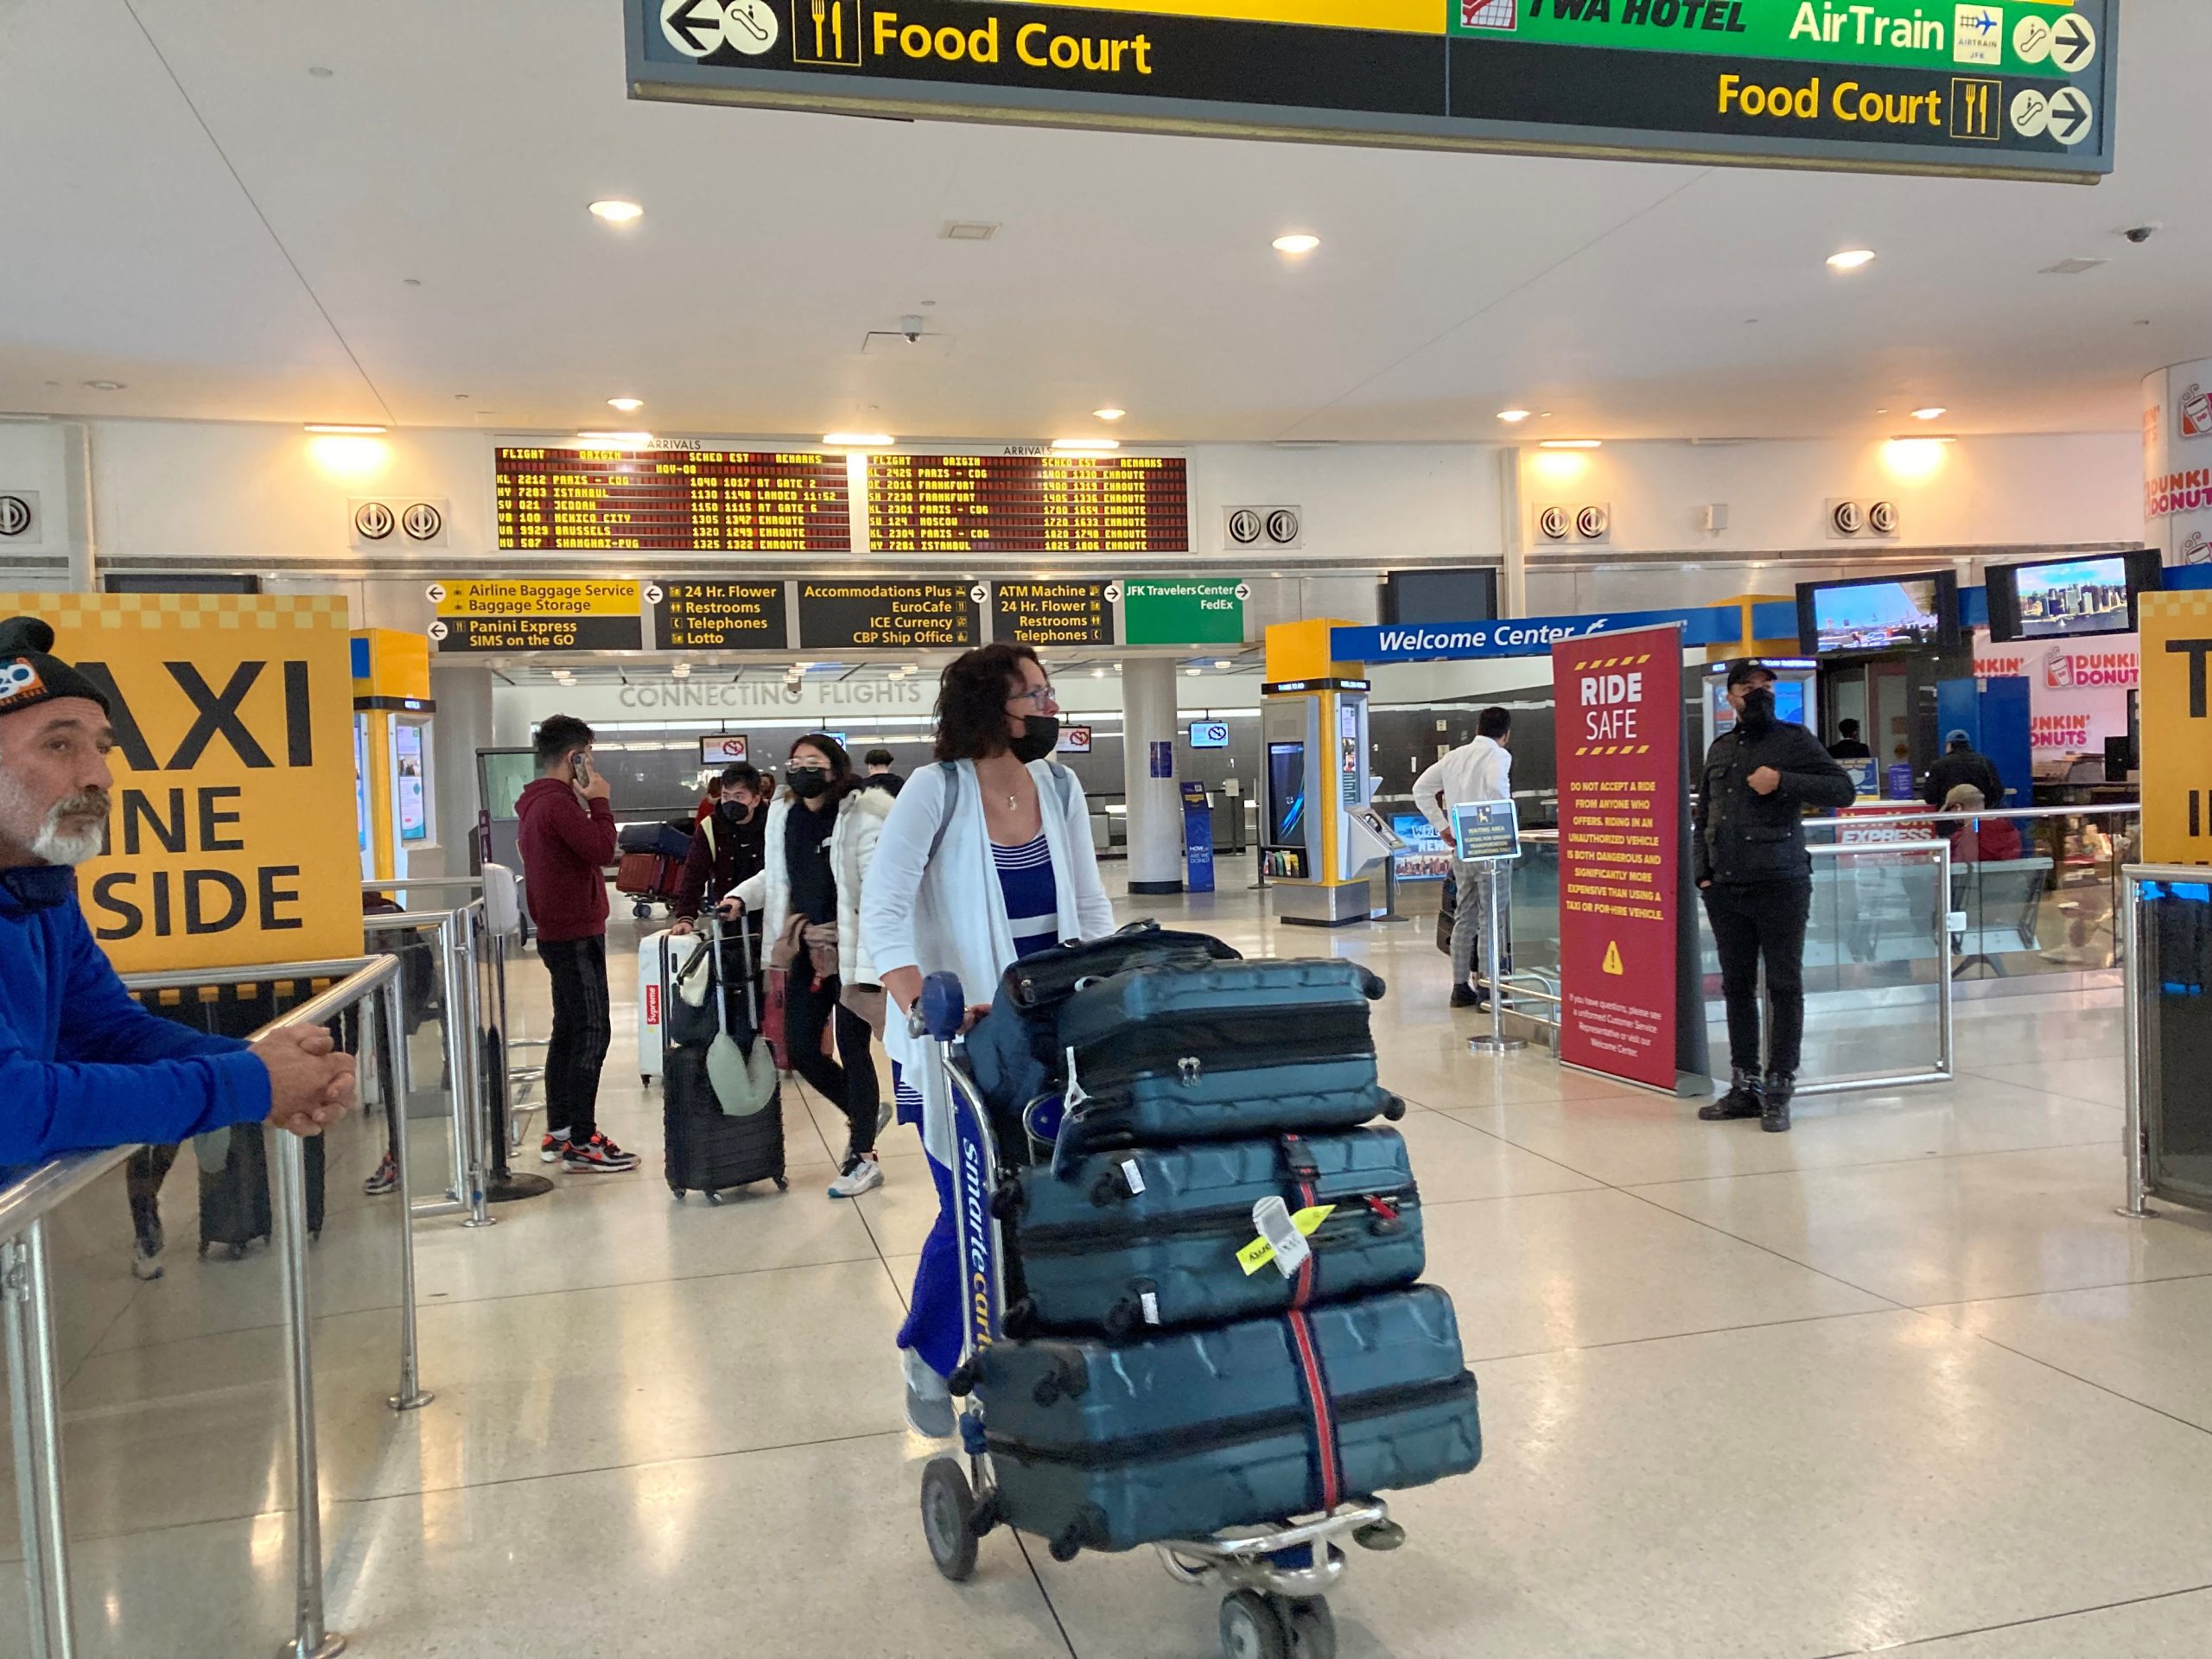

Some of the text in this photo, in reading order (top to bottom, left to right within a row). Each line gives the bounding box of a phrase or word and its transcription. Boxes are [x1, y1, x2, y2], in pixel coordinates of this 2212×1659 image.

[1529, 0, 1746, 33] TWA HOTEL
[1789, 1, 1943, 51] AirTrain
[873, 12, 1152, 75] Food Court
[1958, 39, 1998, 48] AIRTRAIN
[1969, 51, 1985, 60] JFK
[1718, 73, 1942, 126] Food Court
[647, 439, 701, 450] ARRIVALS
[1003, 445, 1052, 456] ARRIVALS
[503, 449, 823, 464] FLIGHT ORIGIN SCHED EST REMARKS
[872, 455, 1162, 468] FLIGHT ORIGIN SCHED EST REMARKS
[918, 469, 950, 479] PARIS
[518, 475, 547, 485] 2212
[553, 475, 588, 486] PARIS
[690, 478, 718, 487] 1040
[725, 478, 751, 488] 1017
[757, 479, 769, 488] AT
[776, 479, 802, 489] GATE
[810, 480, 817, 489] 2
[918, 480, 975, 491] FRANKFURT
[2151, 467, 2212, 495] DUNKI
[554, 488, 836, 501] ISTANBUL 1130 LANDED 11:52
[918, 493, 976, 503] FRANKFURT
[556, 500, 817, 513] JEDDAH 1115 AT GATE 6
[2151, 488, 2212, 516] DONUT
[919, 505, 951, 515] PARIS
[555, 513, 804, 525] MEXICO CITY ENROUTE
[920, 517, 957, 527] MOSCOW
[556, 526, 805, 538] BRUSSELS 1320 ENROUTE
[921, 529, 952, 538] PARIS
[556, 537, 806, 550] SHANGHAI-PVG 1325 1322 ENROUTE
[922, 541, 971, 550] ISTANBUL
[469, 584, 634, 599] Airline Baggage Service
[685, 586, 777, 598] 24 Hr. Flower
[804, 585, 952, 597] Accommodations Plus
[999, 585, 1086, 597] ATM Machine
[1126, 583, 1234, 597] JFK Travelers Center
[469, 600, 591, 613] Baggage Storage
[686, 601, 761, 613] Restrooms
[892, 601, 952, 613] EuroCafe
[1001, 601, 1086, 613] 24 Hr. Flower
[1200, 600, 1234, 612] FedEx
[469, 620, 577, 635] Panini Express
[686, 617, 768, 632] Telephones
[869, 616, 953, 631] ICE Currency
[1020, 615, 1088, 627] Restrooms
[469, 634, 575, 646] SIMS on the GO
[687, 632, 724, 645] Lotto
[853, 631, 953, 646] CBP Ship Office
[1014, 630, 1088, 645] Telephones
[1379, 624, 1574, 652] Welcome Center
[1974, 657, 2024, 672] NKIN'
[2075, 652, 2139, 670] DUNKI
[2075, 669, 2139, 687] DONUT
[620, 681, 921, 707] CONNECTING FLIGHTS
[1580, 672, 1642, 706] RIDE
[74, 660, 313, 771] AXI
[1586, 709, 1637, 740] SAFE
[1570, 782, 1656, 791] DO NOT ACCEPT A RIDE
[1575, 799, 1649, 810] FROM ANYONE WHO
[99, 786, 244, 857] NE
[1605, 817, 1630, 827] RIDING
[1631, 817, 1640, 827] IN
[1641, 817, 1653, 828] AN
[1568, 833, 1659, 846] UNAUTHORIZED VEHICLE
[1841, 828, 1933, 844] EXPRESS
[1567, 850, 1661, 865] IS BOTH DANGEROUS AND
[1574, 868, 1652, 882] SIGNIFICANTLY MORE
[1567, 884, 1662, 901] EXPENSIVE THAN USING A
[92, 865, 303, 940] SIDE
[1566, 900, 1580, 911] TAXI
[1581, 902, 1592, 912] OR
[647, 986, 656, 1024] Supreme
